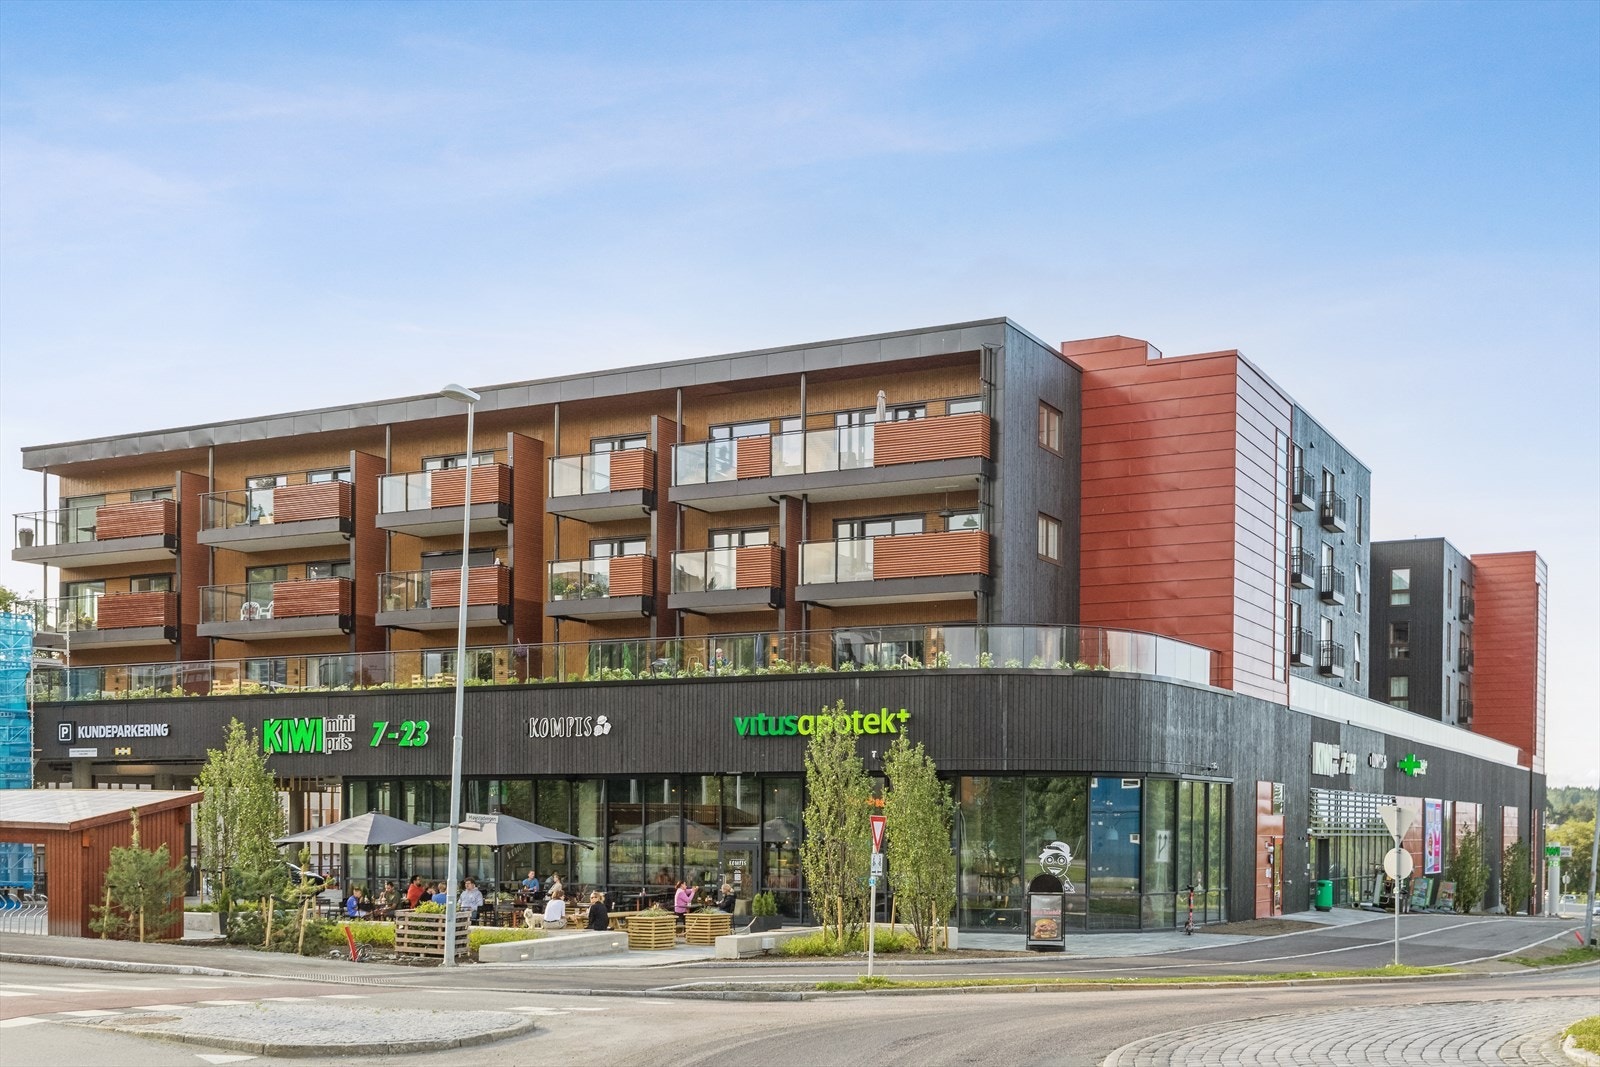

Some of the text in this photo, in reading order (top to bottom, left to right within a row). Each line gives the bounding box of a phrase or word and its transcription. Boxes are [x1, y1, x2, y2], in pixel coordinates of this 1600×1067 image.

[61, 723, 169, 738] P KUNDEPARKERING
[326, 714, 356, 732] mini
[369, 720, 430, 747] 7-23
[529, 716, 593, 738] KOMPIS
[263, 717, 326, 753] KIWI
[325, 733, 353, 754] pris
